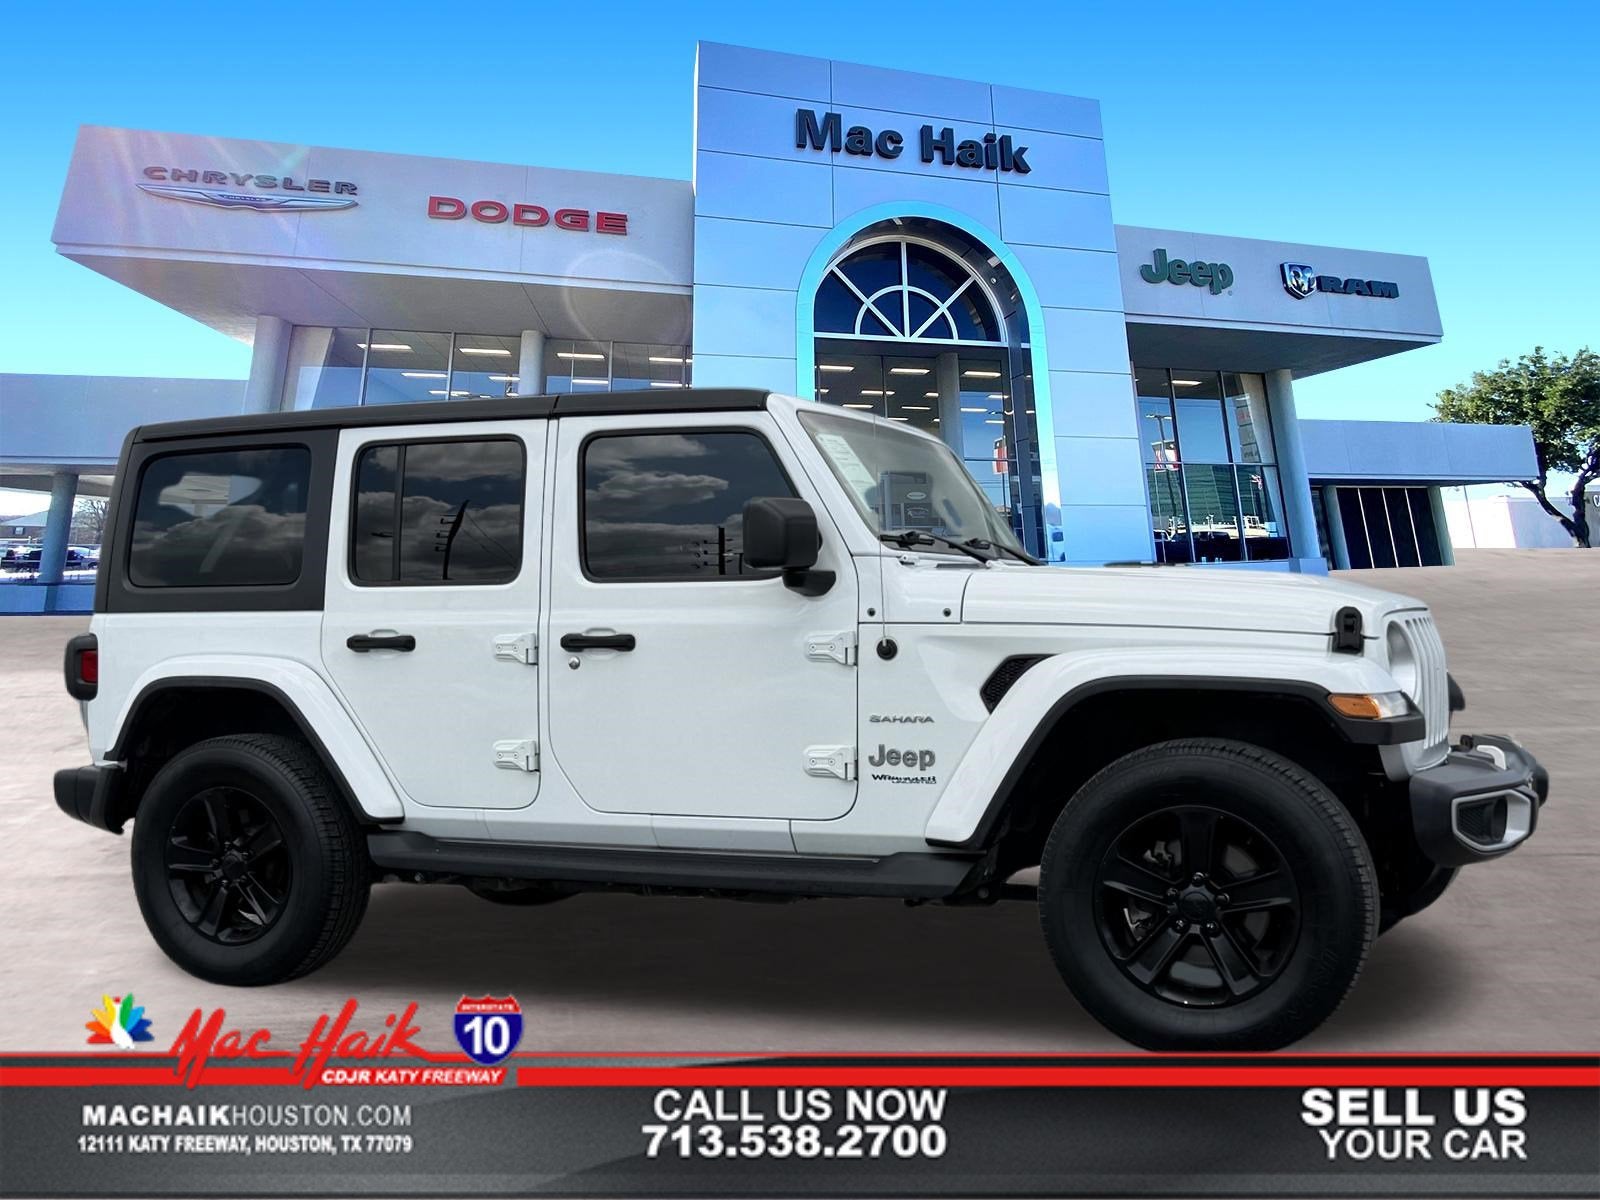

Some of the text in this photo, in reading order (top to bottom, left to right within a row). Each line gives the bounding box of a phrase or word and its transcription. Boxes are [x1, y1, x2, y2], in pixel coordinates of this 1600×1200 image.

[796, 108, 1032, 174] Mac Haik
[143, 166, 358, 196] CHRYSLER
[428, 195, 628, 236] DODGE
[1140, 248, 1234, 295] Jeep
[1315, 275, 1400, 299] RAM
[869, 715, 935, 724] SAHARA
[868, 744, 936, 771] Jeep
